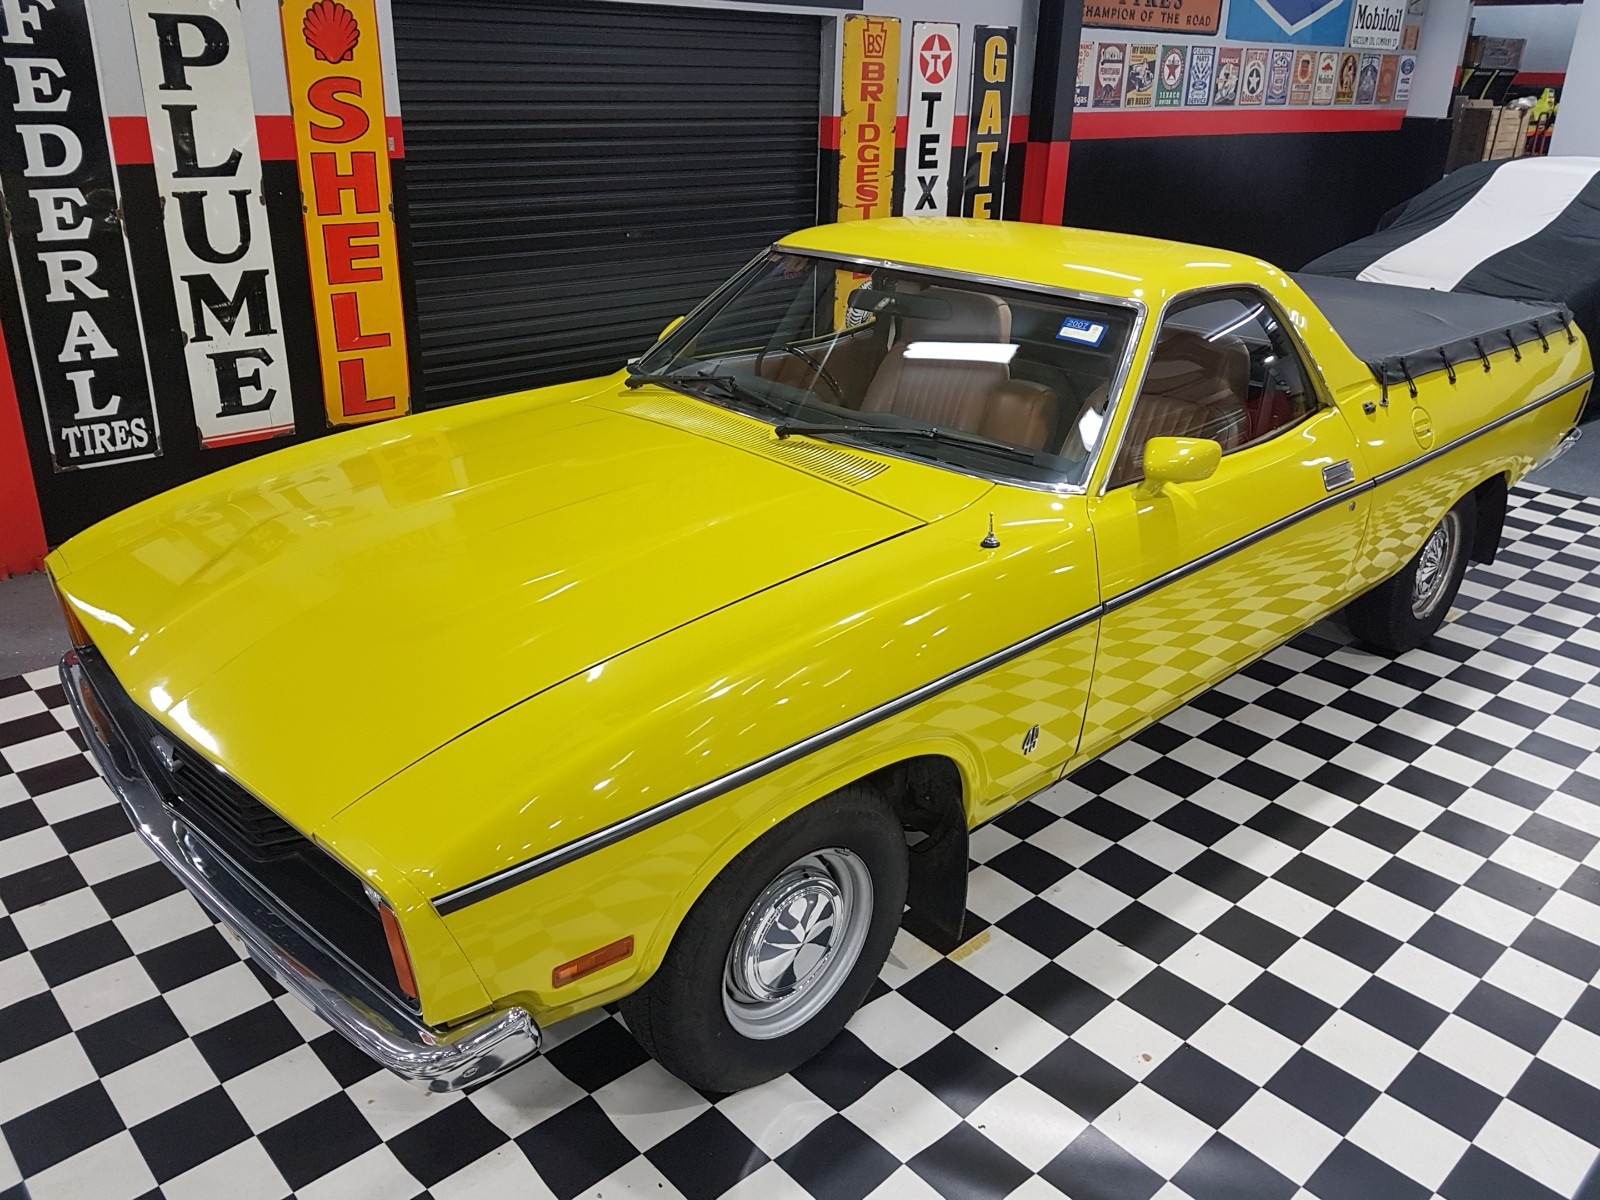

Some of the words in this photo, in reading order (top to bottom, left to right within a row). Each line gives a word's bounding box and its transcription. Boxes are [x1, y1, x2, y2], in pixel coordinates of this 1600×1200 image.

[1082, 6, 1136, 20] HAMPION
[1140, 10, 1154, 22] OF
[1161, 12, 1180, 24] THE
[1186, 15, 1211, 26] ROAD
[1355, 4, 1403, 32] Mobiloil
[867, 34, 883, 54] BS
[1193, 47, 1214, 55] GENUINE
[855, 62, 885, 220] BRIDGEST
[914, 92, 942, 210] TEX
[2, 0, 121, 420] FEDERAL
[148, 12, 278, 418] PLUME
[307, 76, 396, 417] SHELL
[1066, 320, 1089, 330] 2007
[61, 418, 150, 458] TIRES
